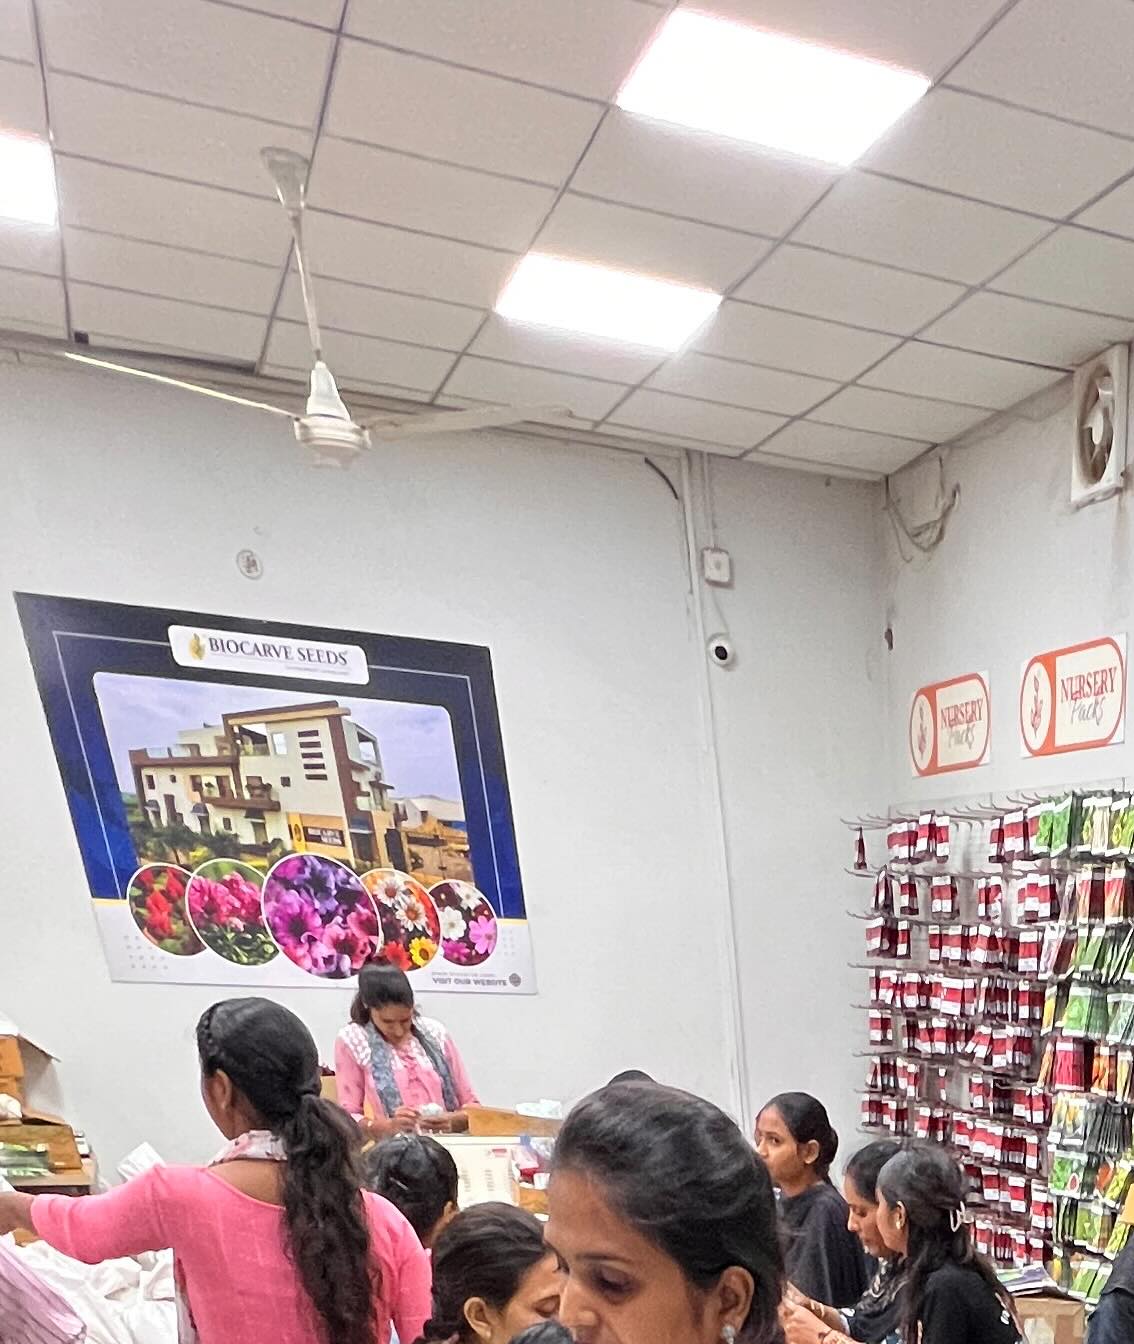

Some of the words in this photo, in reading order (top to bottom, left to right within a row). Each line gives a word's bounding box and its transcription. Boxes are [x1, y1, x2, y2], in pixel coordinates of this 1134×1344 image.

[208, 637, 294, 661] BIOCARVE
[297, 648, 348, 665] SEEDS
[1060, 666, 1117, 704] NURSERY
[941, 698, 983, 729] NURSERY
